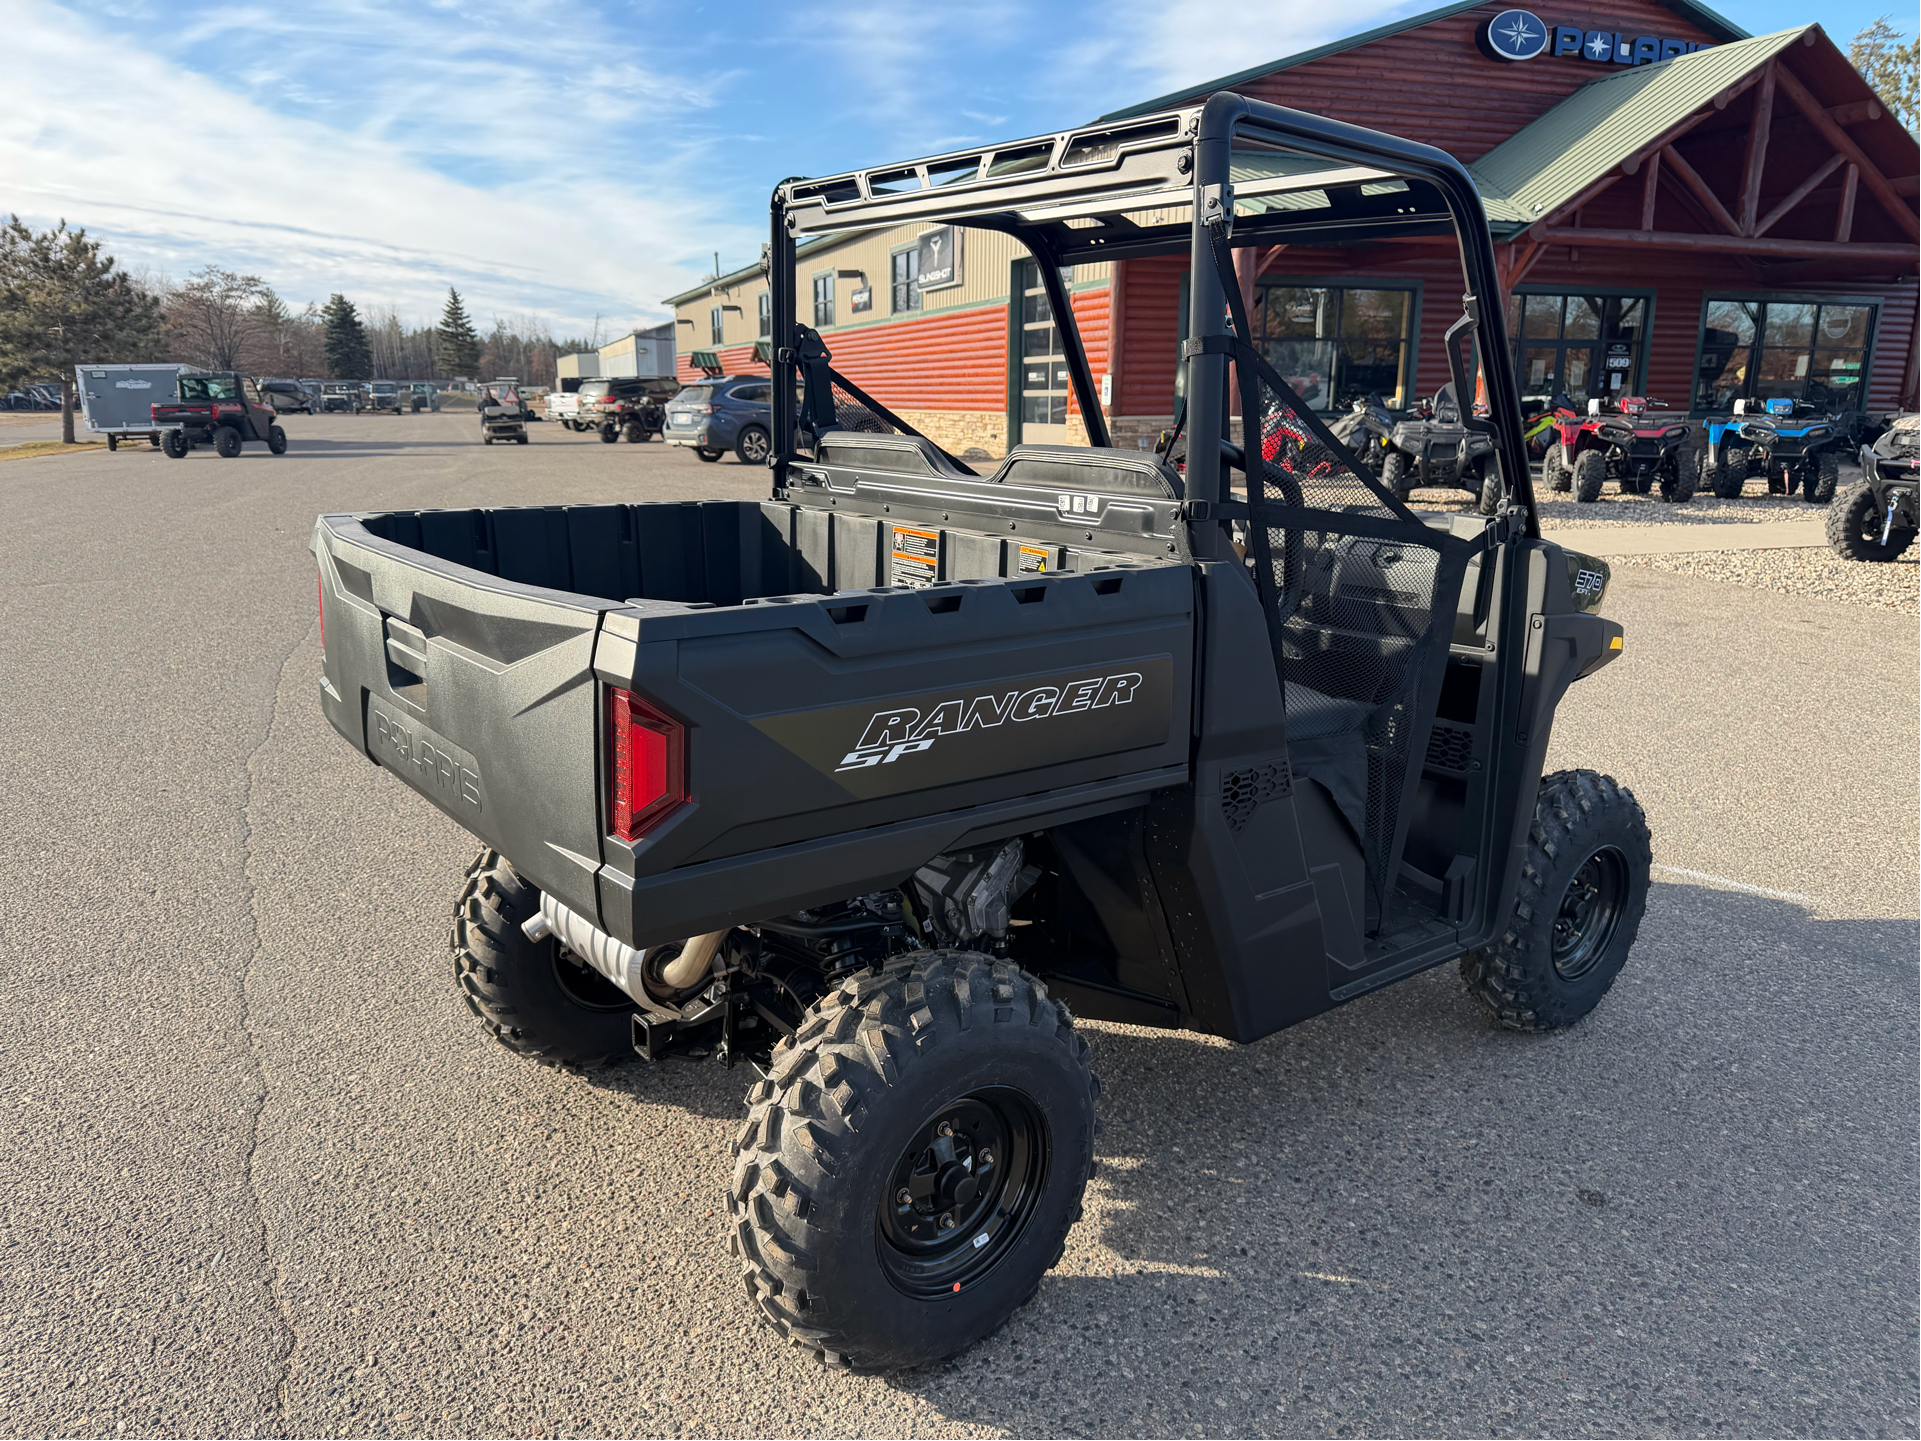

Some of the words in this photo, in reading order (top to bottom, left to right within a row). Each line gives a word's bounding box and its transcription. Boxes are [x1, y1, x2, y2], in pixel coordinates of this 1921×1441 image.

[1554, 26, 1715, 66] POLAR
[1609, 357, 1630, 368] 509
[1575, 569, 1603, 591] 570
[855, 672, 1143, 750] RANGER
[374, 709, 483, 814] POLARIS
[834, 738, 935, 773] SP
